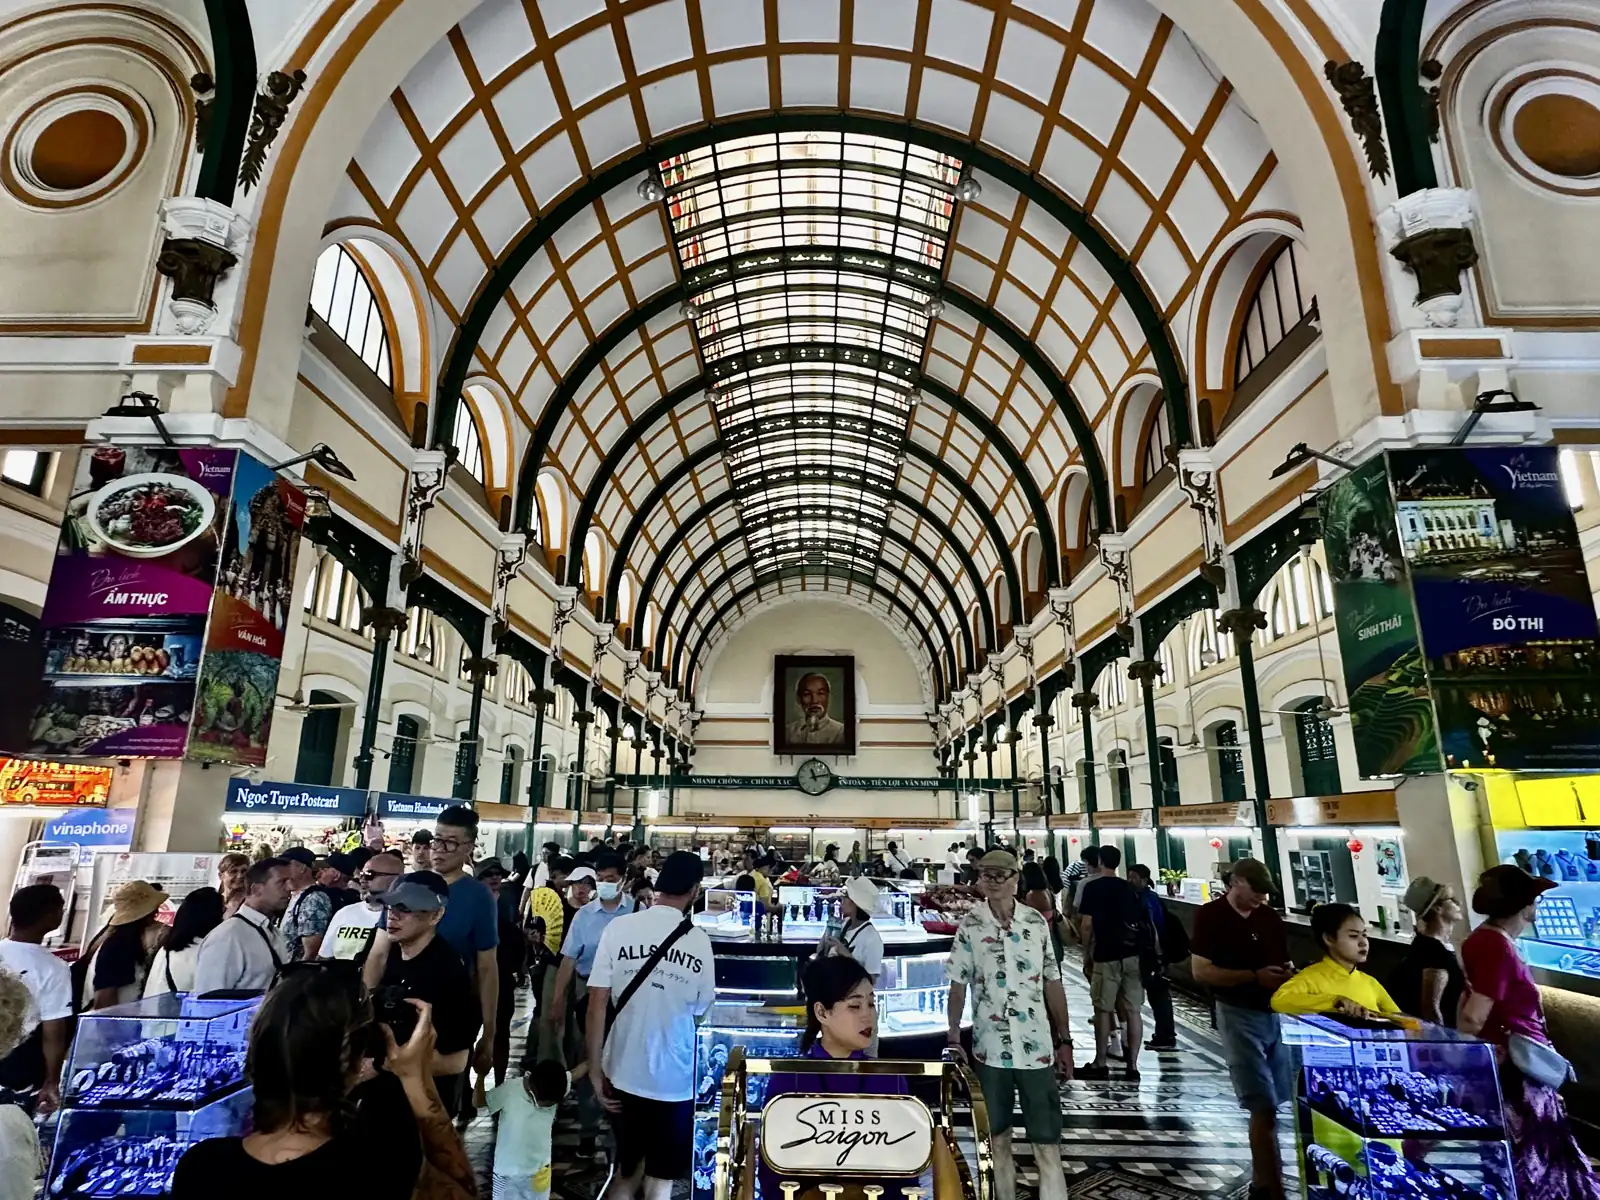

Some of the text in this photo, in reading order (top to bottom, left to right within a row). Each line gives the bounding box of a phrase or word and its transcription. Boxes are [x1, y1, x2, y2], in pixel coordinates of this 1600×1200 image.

[198, 461, 231, 478] Vietnam
[1500, 464, 1558, 490] Vietnam
[129, 592, 169, 607] THỰC
[1358, 613, 1402, 641] SINH THÁI
[1492, 615, 1543, 633] ĐÔ THỊ
[692, 777, 716, 785] NHANH
[717, 776, 743, 785] CHÓNG
[750, 776, 775, 785] CHÍNH
[920, 778, 939, 787] MINH
[236, 787, 339, 809] Ngoc Tuyet Postcard
[387, 800, 414, 813] Vietnam
[52, 821, 129, 837] vinaphone
[337, 926, 373, 940] FIRE
[818, 1109, 881, 1125] MISS
[780, 1101, 917, 1167] Saigon
